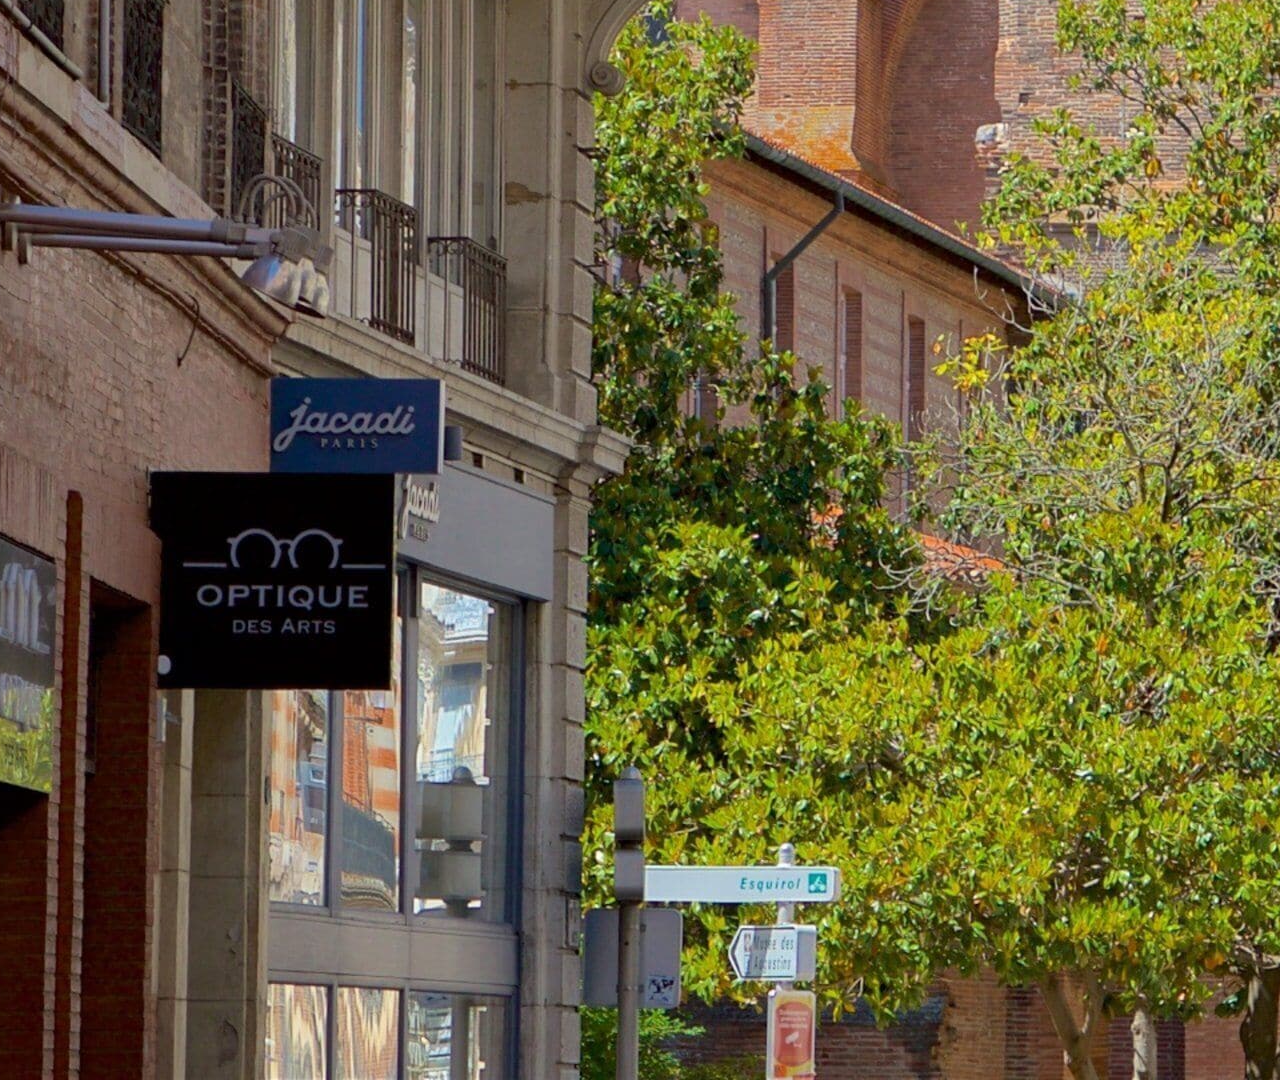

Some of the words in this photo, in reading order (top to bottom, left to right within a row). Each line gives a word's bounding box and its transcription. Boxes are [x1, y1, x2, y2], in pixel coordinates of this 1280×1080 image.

[273, 396, 415, 452] jacadi
[320, 438, 379, 449] PARIS
[196, 584, 369, 610] OPTIQUE
[232, 619, 272, 633] DES
[280, 618, 336, 634] ARTS
[740, 877, 801, 891] Esquirol
